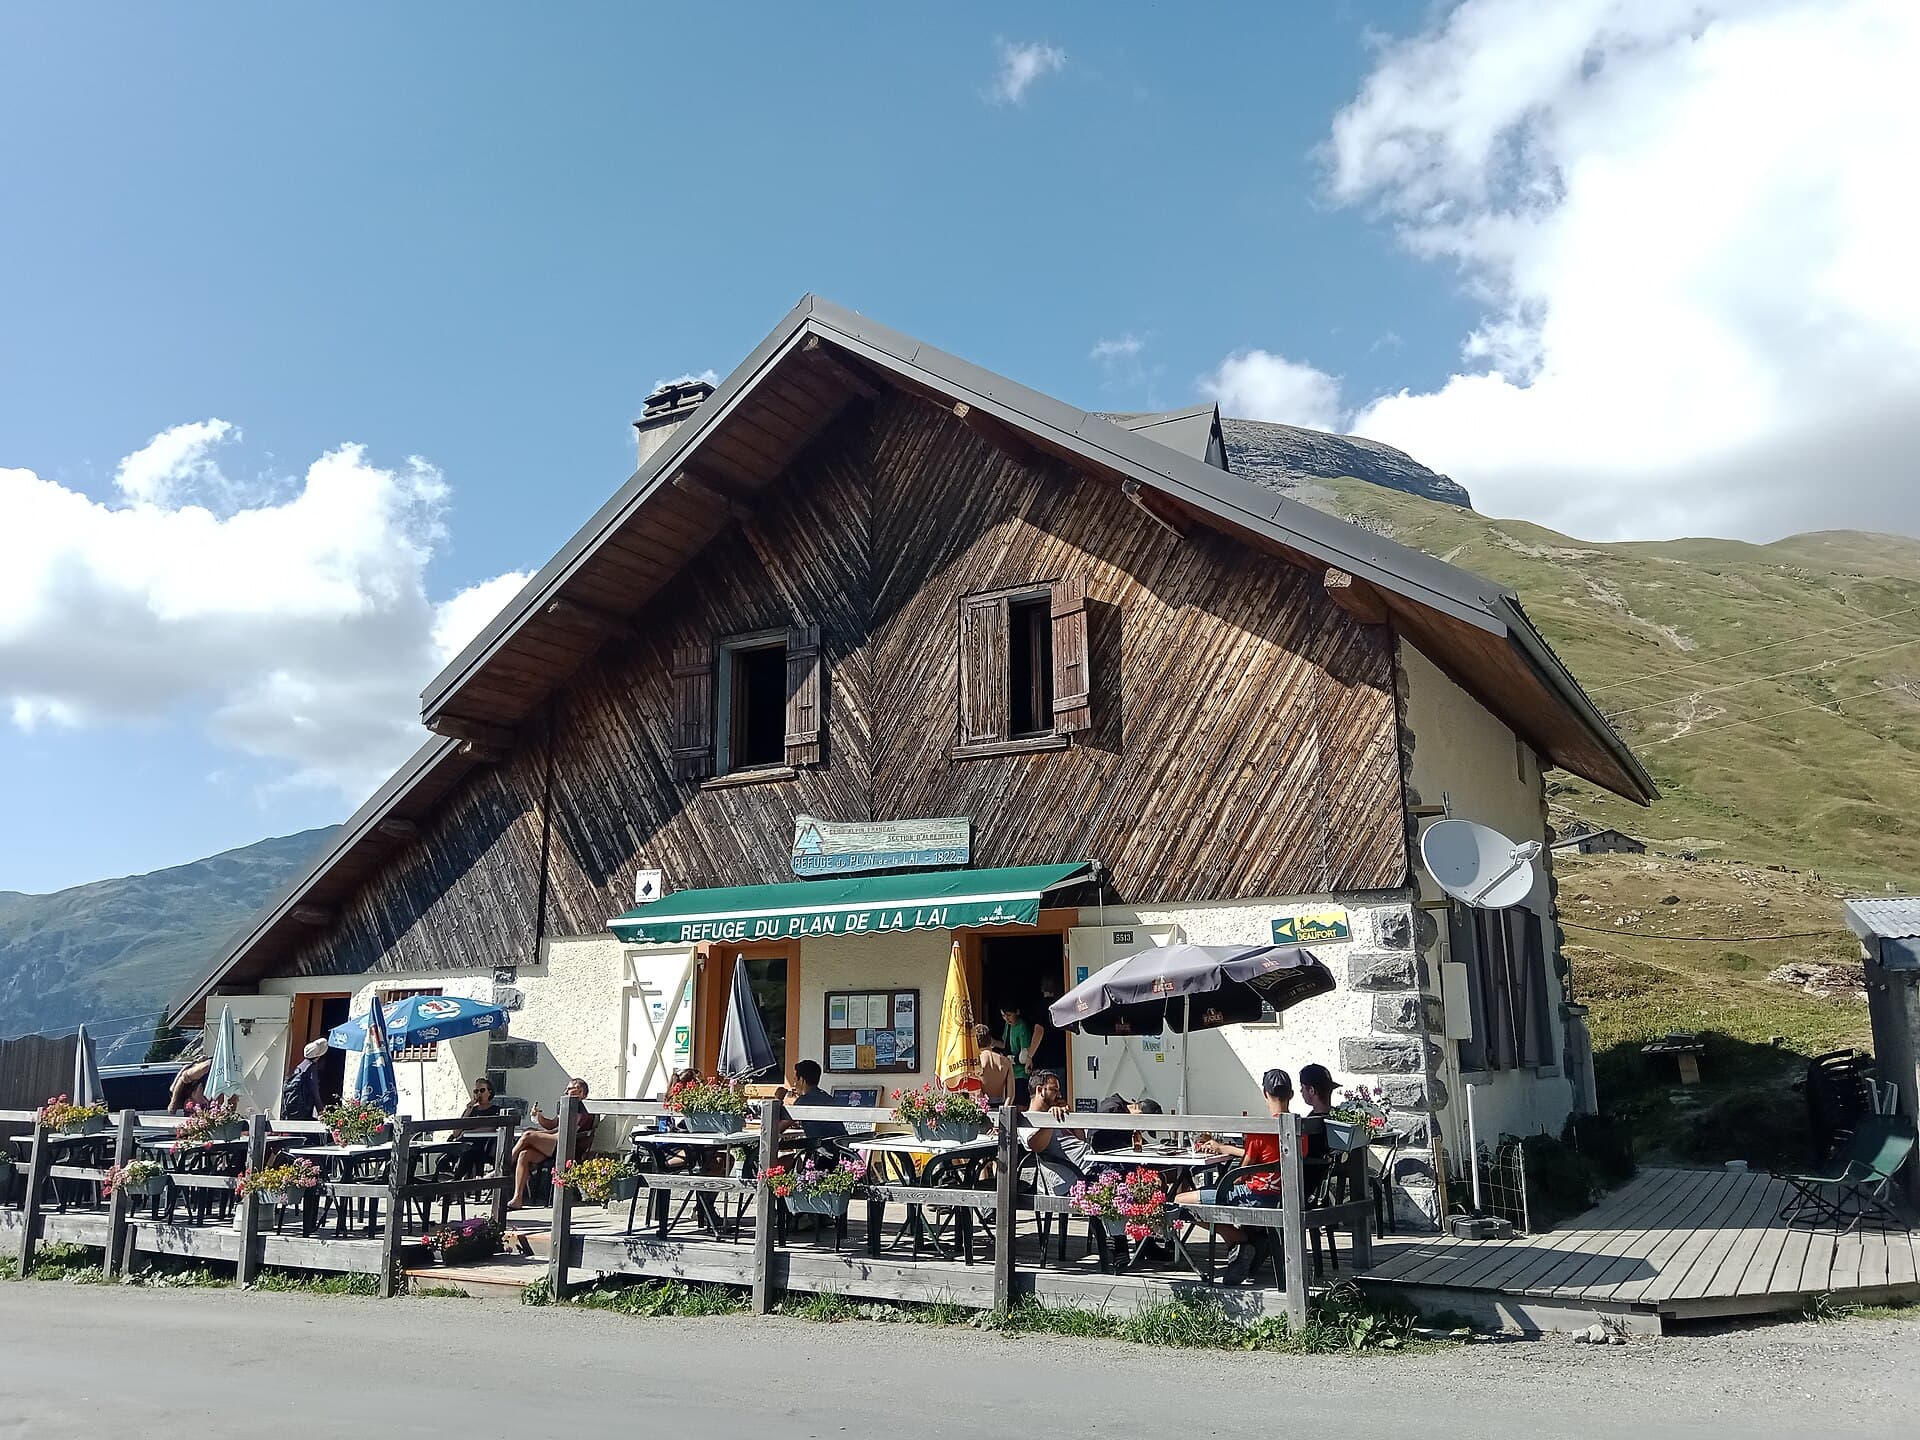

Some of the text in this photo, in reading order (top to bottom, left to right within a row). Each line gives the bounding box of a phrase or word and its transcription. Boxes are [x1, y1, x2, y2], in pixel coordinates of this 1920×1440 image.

[794, 856, 832, 869] REFUGE
[850, 855, 875, 867] PLAN
[878, 857, 888, 865] de
[903, 853, 918, 864] LAI
[681, 907, 948, 940] REFUGE DU PLAN DE LA LAI
[1115, 933, 1131, 942] 5513
[1297, 929, 1337, 941] BEAUFORT
